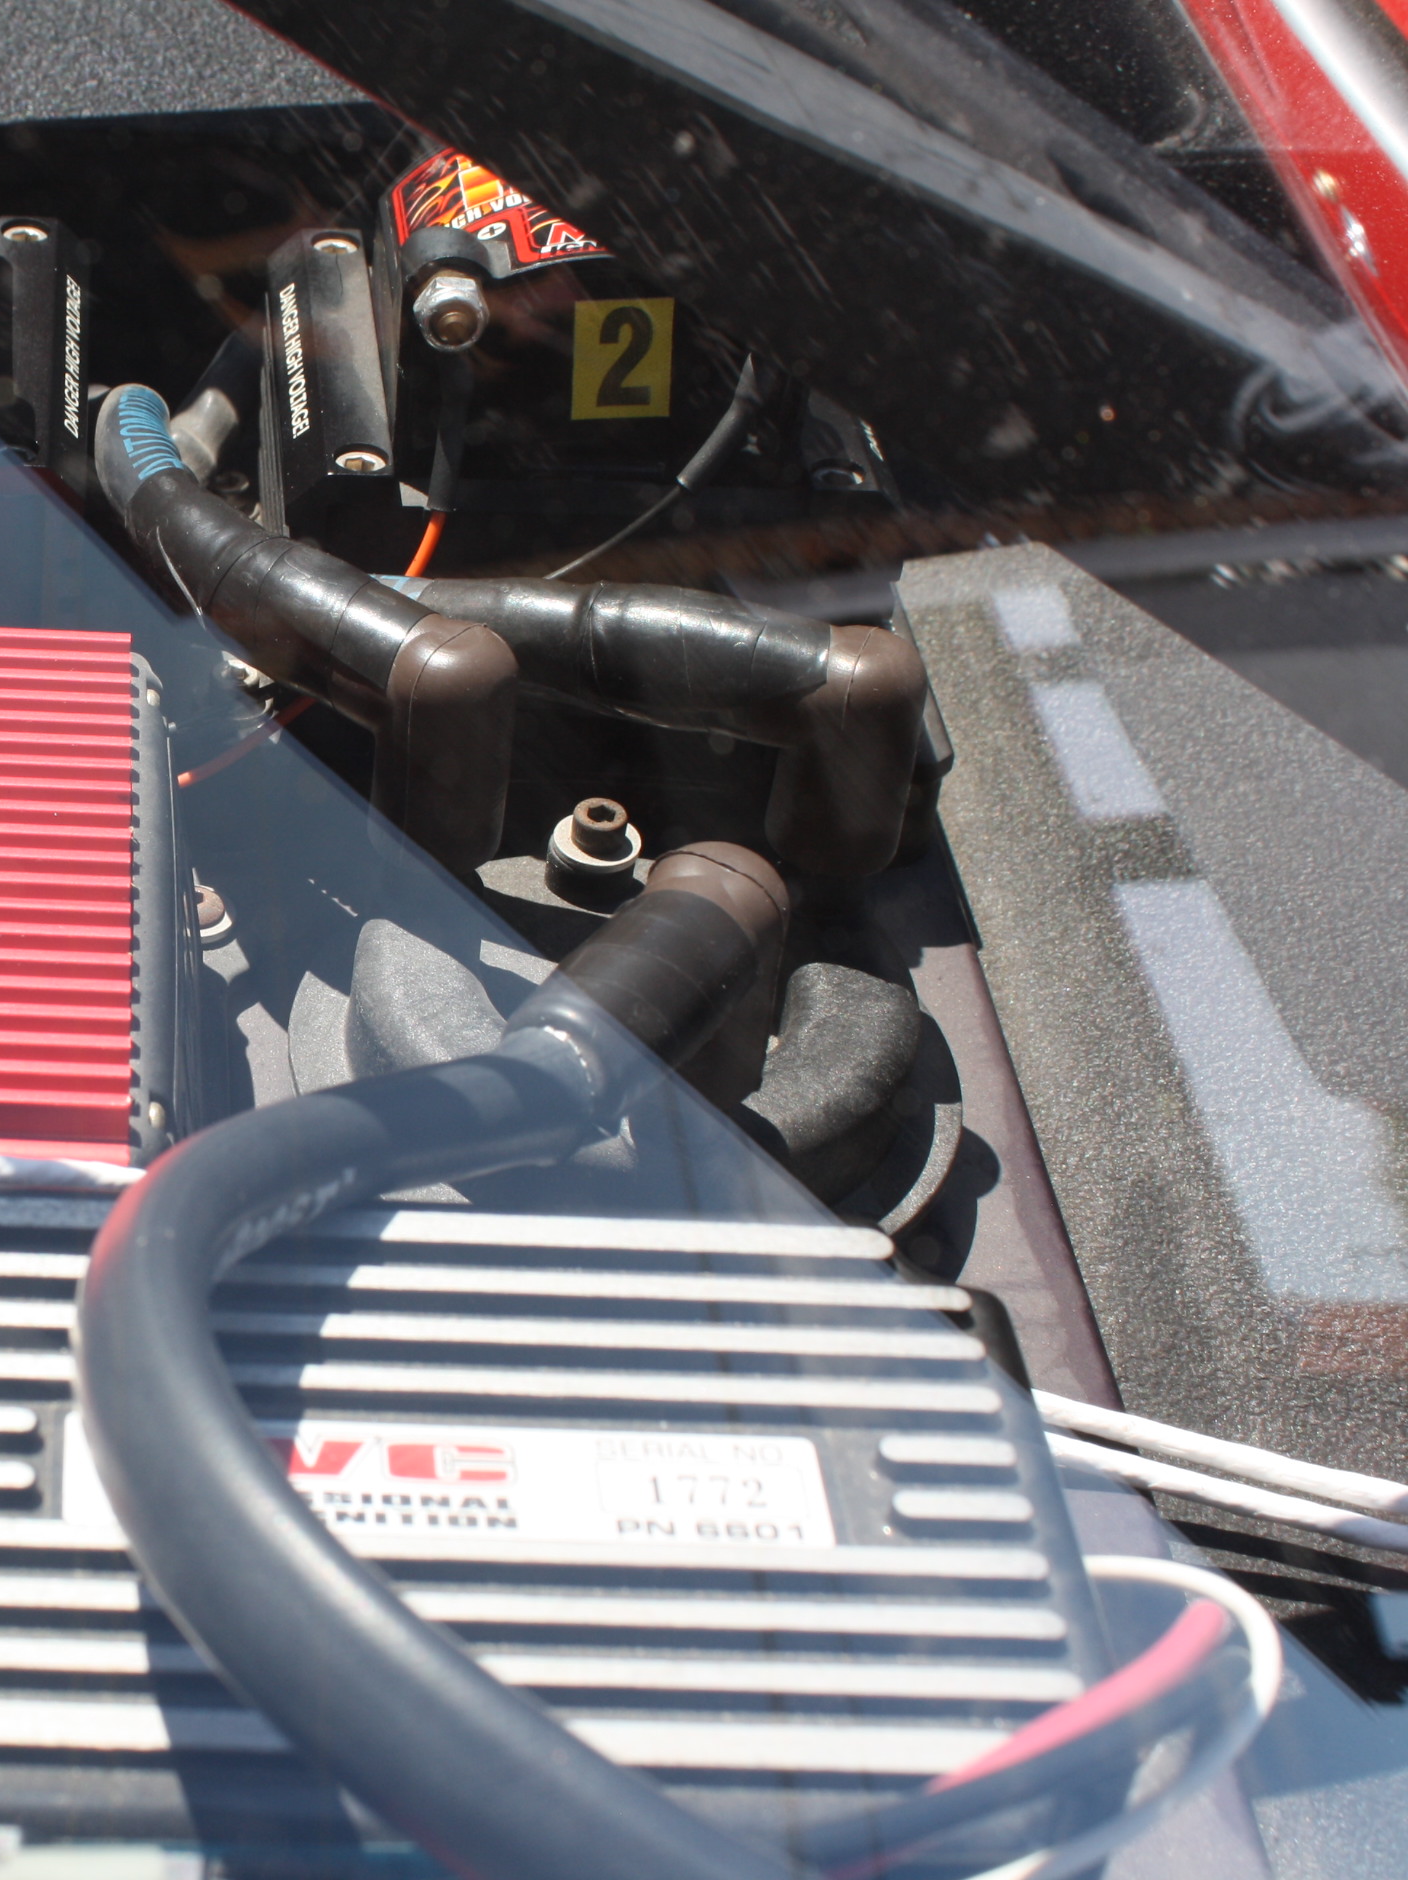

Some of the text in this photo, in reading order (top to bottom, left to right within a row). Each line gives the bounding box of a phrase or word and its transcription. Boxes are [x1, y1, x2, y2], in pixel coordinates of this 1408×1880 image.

[64, 274, 82, 439] DANGER HIGH VOLTAGE!
[279, 282, 311, 440] DANGER HIGH VOLTAGE!
[596, 305, 655, 408] 2
[595, 1439, 720, 1463] SERIAL
[649, 1474, 769, 1509] 1772
[616, 1517, 806, 1542] PN 6601
